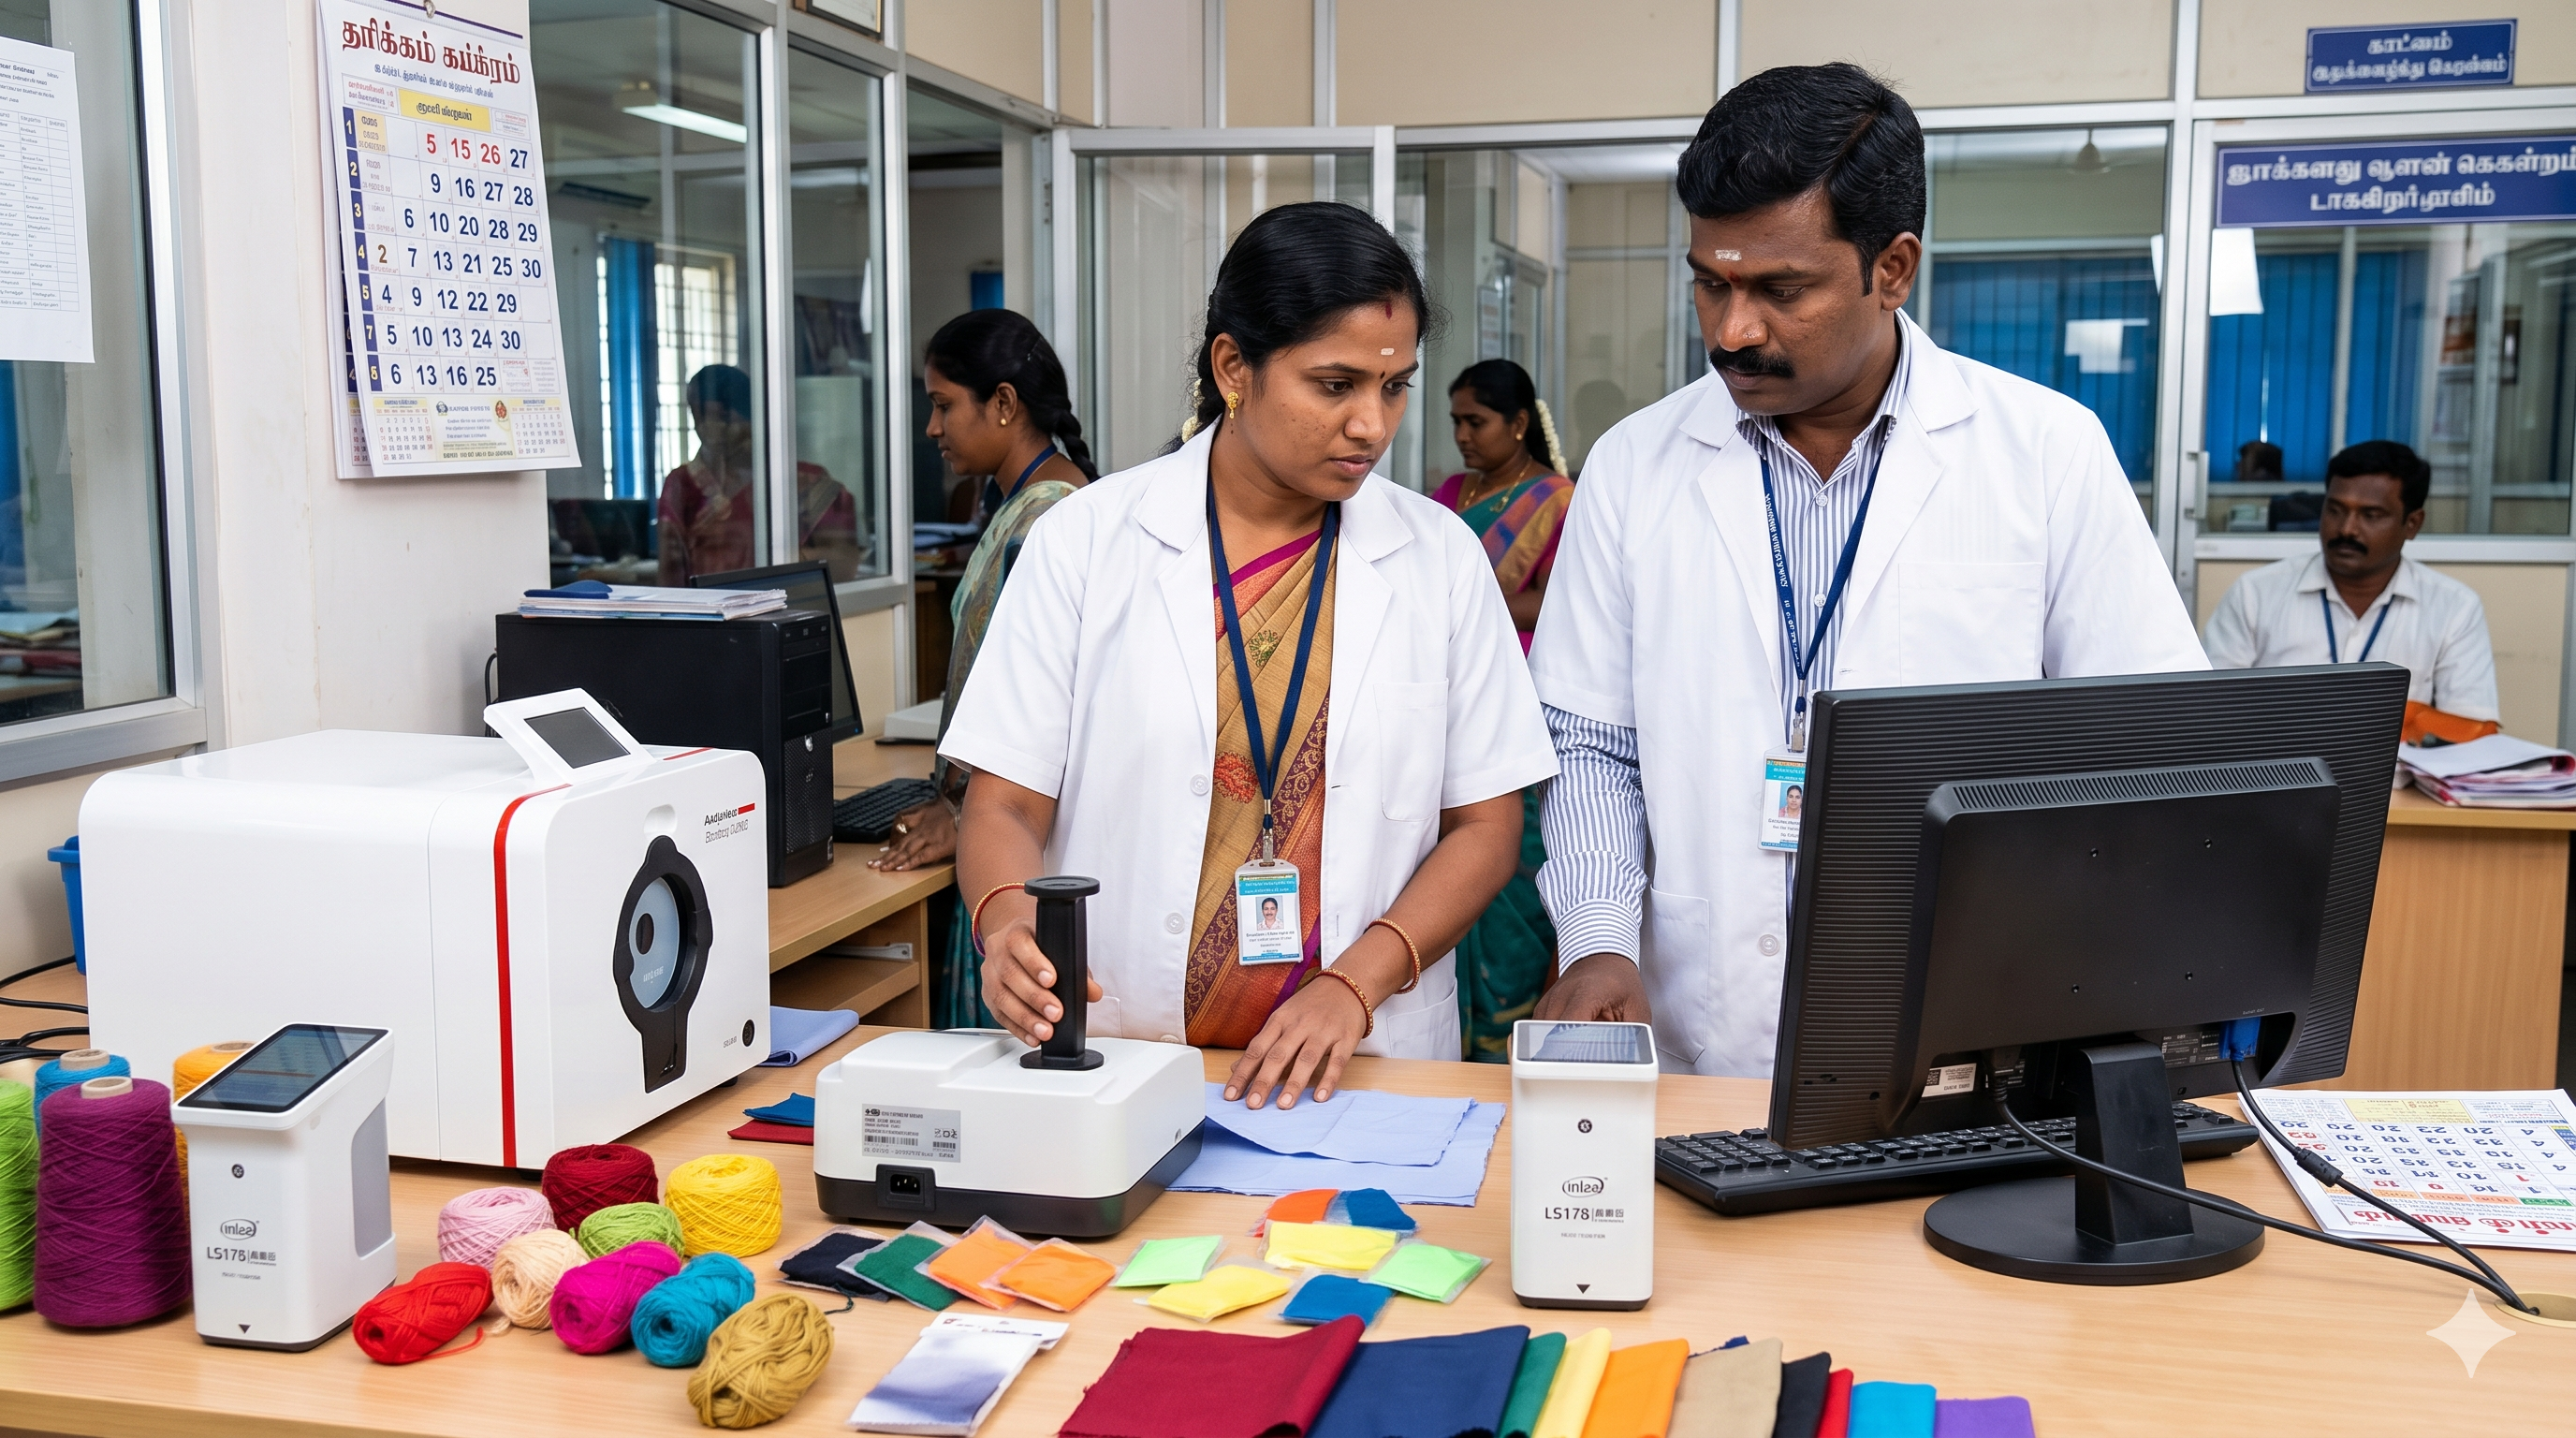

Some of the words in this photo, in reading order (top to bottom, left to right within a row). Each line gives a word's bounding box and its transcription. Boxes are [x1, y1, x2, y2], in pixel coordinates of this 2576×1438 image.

[345, 121, 352, 134] 1
[427, 133, 436, 154] 5
[451, 138, 471, 160] 15
[480, 143, 500, 164] 26
[510, 149, 528, 169] 27
[350, 162, 358, 176] 2
[432, 173, 440, 193] 9
[456, 178, 475, 198] 16
[485, 182, 503, 201] 27
[514, 186, 533, 206] 28
[355, 203, 361, 216] 3
[405, 209, 414, 228] 6
[430, 213, 448, 233] 10
[459, 215, 478, 237] 20
[489, 218, 508, 239] 28
[518, 223, 537, 242] 29
[358, 245, 365, 258] 4
[377, 244, 388, 263] 2
[407, 247, 417, 268] 7
[433, 251, 453, 271] 13
[462, 254, 482, 273] 21
[491, 257, 512, 276] 25
[521, 259, 541, 279] 30
[362, 286, 369, 300] 5
[382, 284, 392, 304] 4
[412, 286, 421, 307] 9
[437, 289, 458, 310] 12
[467, 291, 489, 312] 22
[496, 294, 517, 314] 29
[366, 325, 373, 339] 7
[387, 324, 397, 345] 5
[412, 326, 432, 346] 10
[442, 328, 462, 347] 13
[471, 329, 492, 349] 24
[500, 330, 520, 349] 30
[390, 363, 402, 385] 6
[417, 364, 437, 386] 13
[446, 365, 468, 386] 16
[476, 366, 497, 387] 25
[1545, 1207, 1589, 1220] LS178
